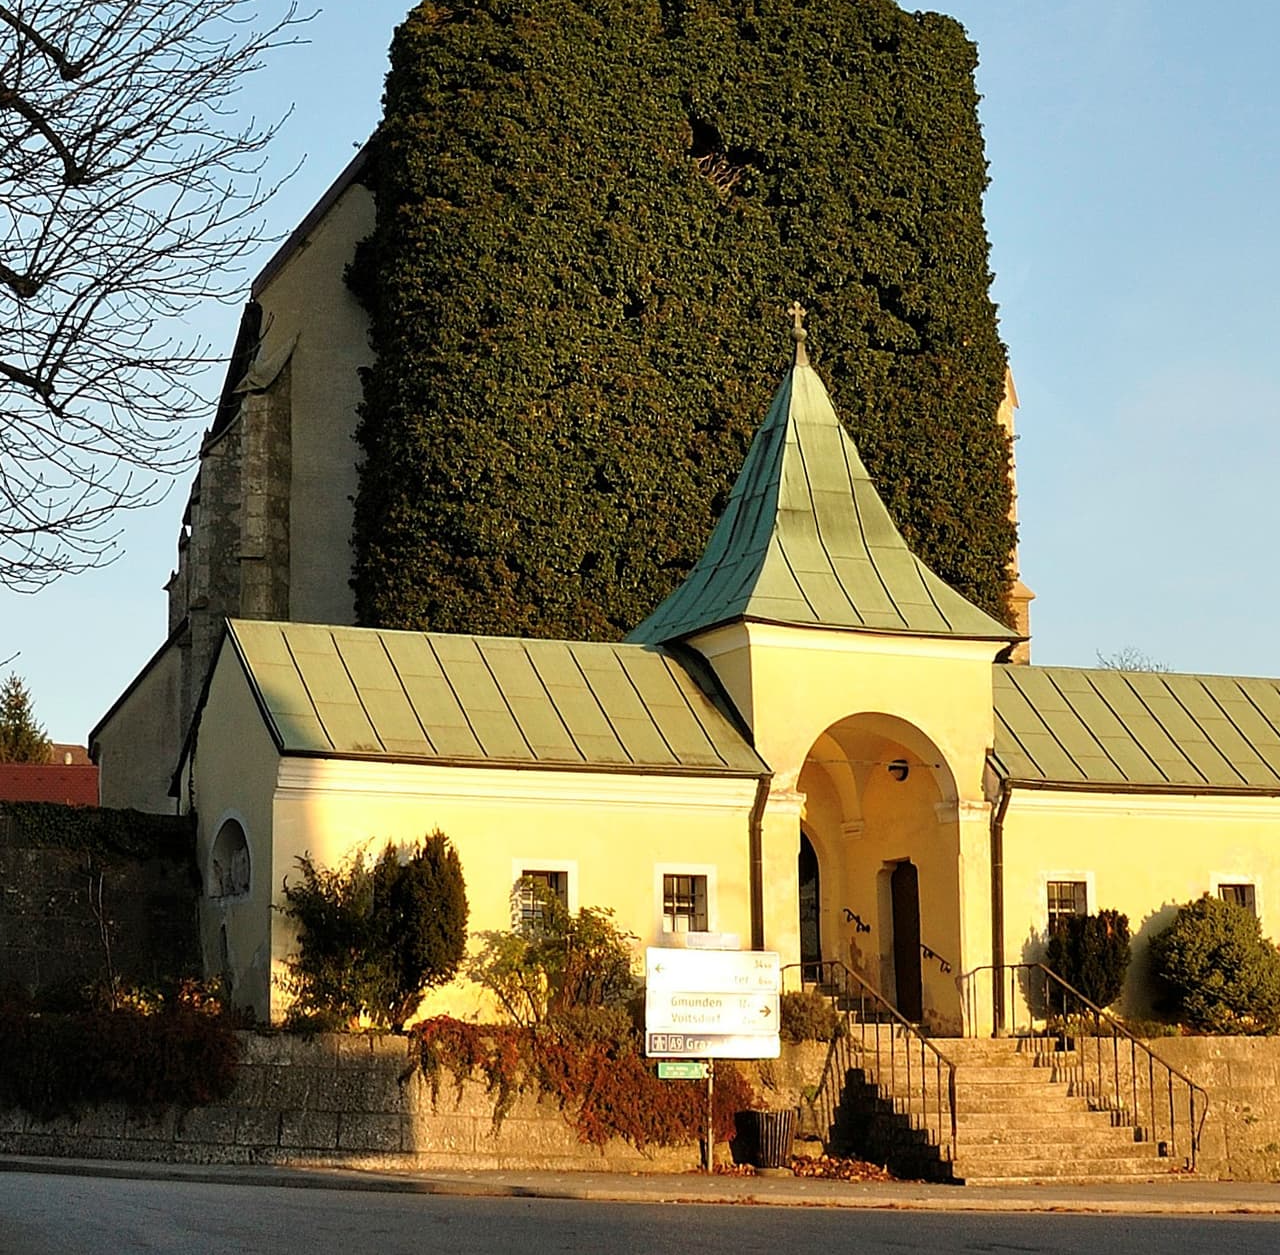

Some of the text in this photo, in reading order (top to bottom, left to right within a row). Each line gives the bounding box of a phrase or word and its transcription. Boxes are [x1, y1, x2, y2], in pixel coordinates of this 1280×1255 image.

[671, 996, 722, 1008] Gmunden
[670, 1038, 682, 1050] A9
[686, 1037, 712, 1050] Graz
